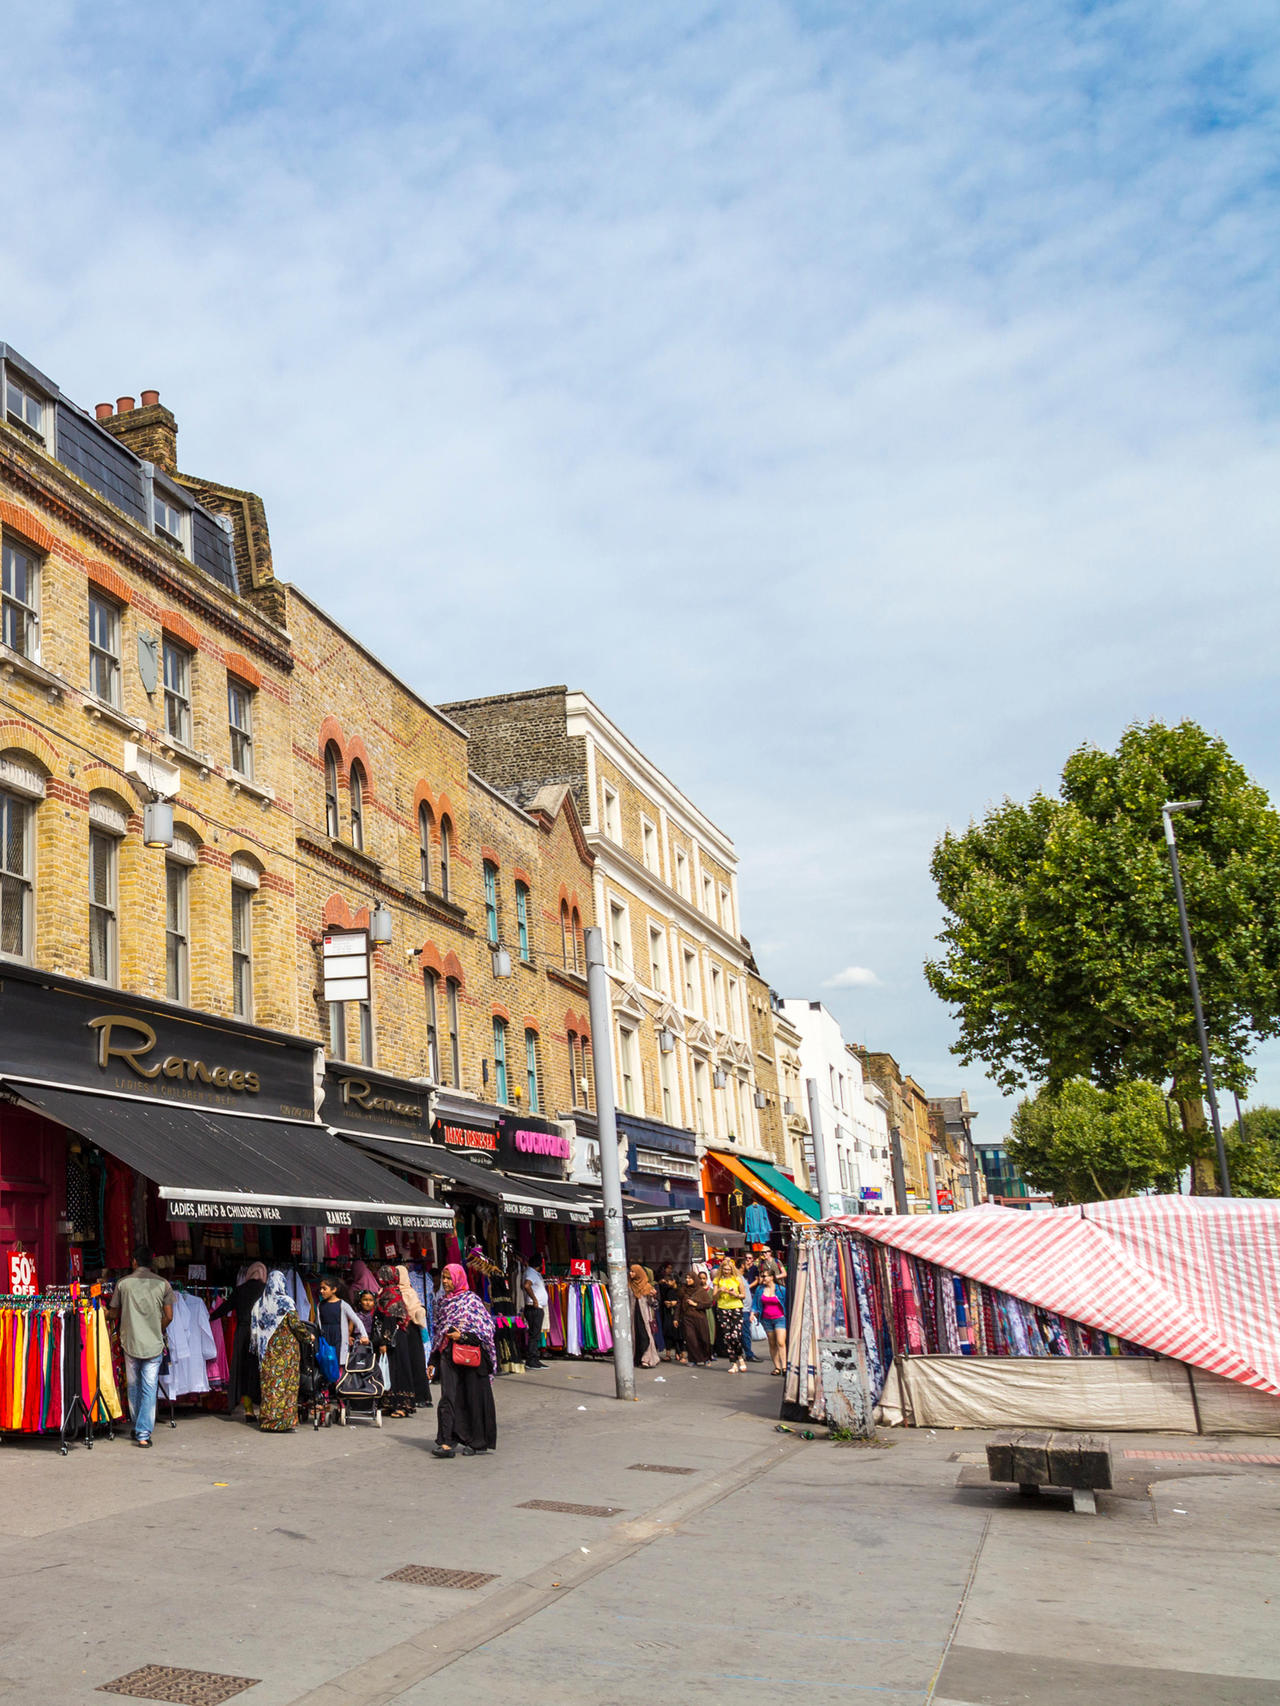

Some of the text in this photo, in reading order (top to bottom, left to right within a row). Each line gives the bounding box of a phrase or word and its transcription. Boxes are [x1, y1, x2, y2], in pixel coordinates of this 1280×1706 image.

[87, 1014, 261, 1094] Ranees
[170, 1202, 281, 1220] LADIES, MEN'S & CHILDREN'S WEAR
[326, 1211, 352, 1225] RANEES
[11, 1256, 36, 1285] 50%
[574, 1261, 587, 1275] £4
[12, 1285, 36, 1295] OFF
